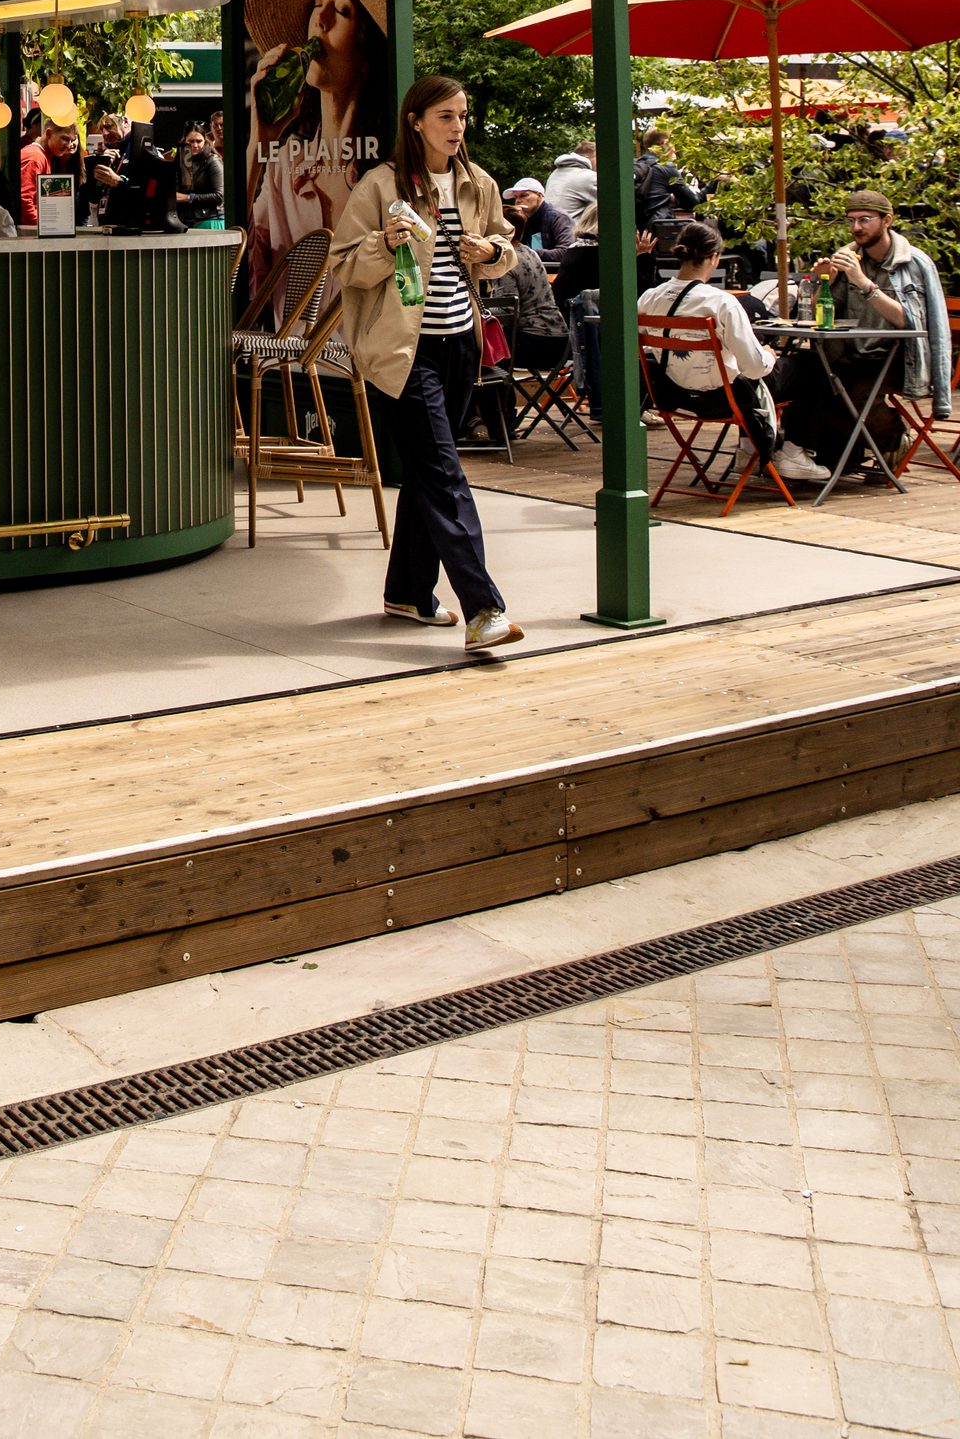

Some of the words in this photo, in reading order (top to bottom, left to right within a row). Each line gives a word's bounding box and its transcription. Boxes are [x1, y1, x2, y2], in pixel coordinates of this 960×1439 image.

[257, 141, 280, 163] LE
[289, 136, 379, 162] PLAISIR
[306, 164, 347, 174] TERRASSE
